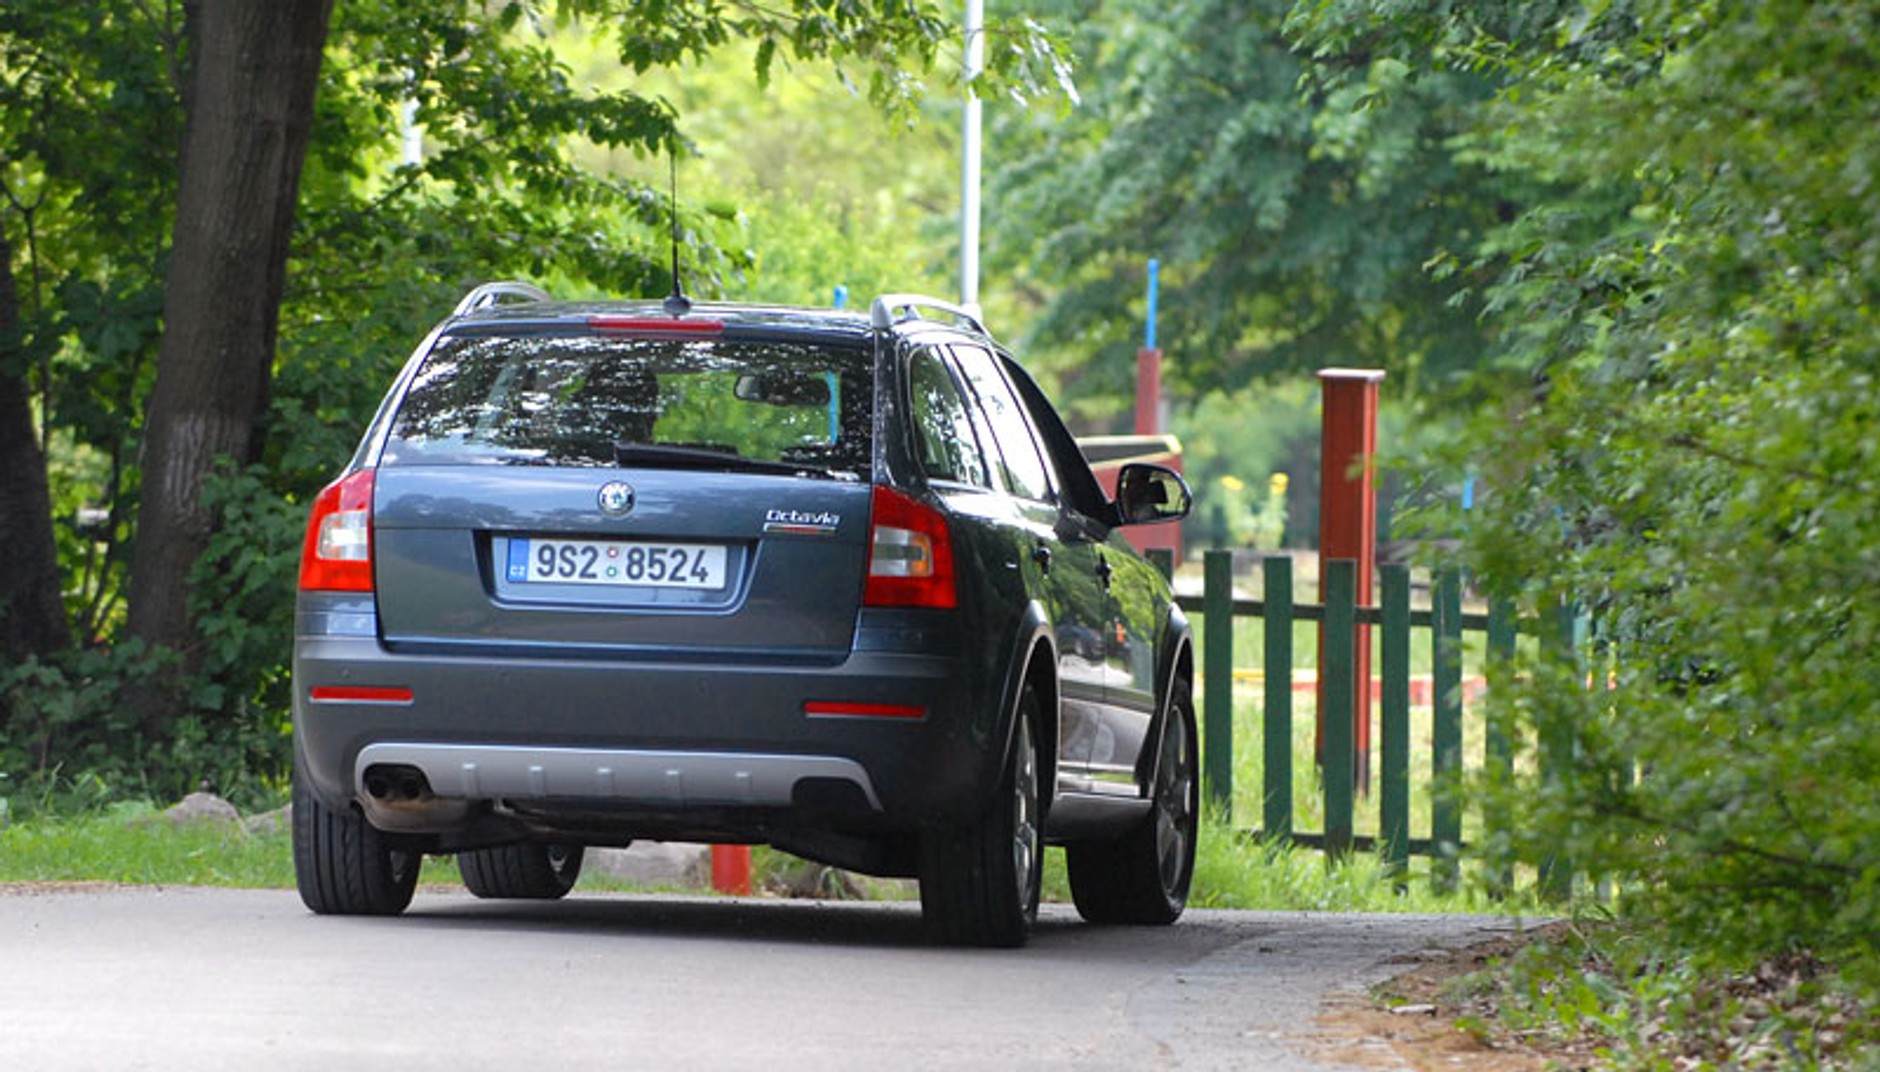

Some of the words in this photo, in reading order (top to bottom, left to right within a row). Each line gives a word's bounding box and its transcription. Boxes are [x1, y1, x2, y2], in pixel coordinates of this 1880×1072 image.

[765, 510, 840, 525] Octavia
[536, 544, 599, 579] 9S2
[625, 547, 709, 583] 8524
